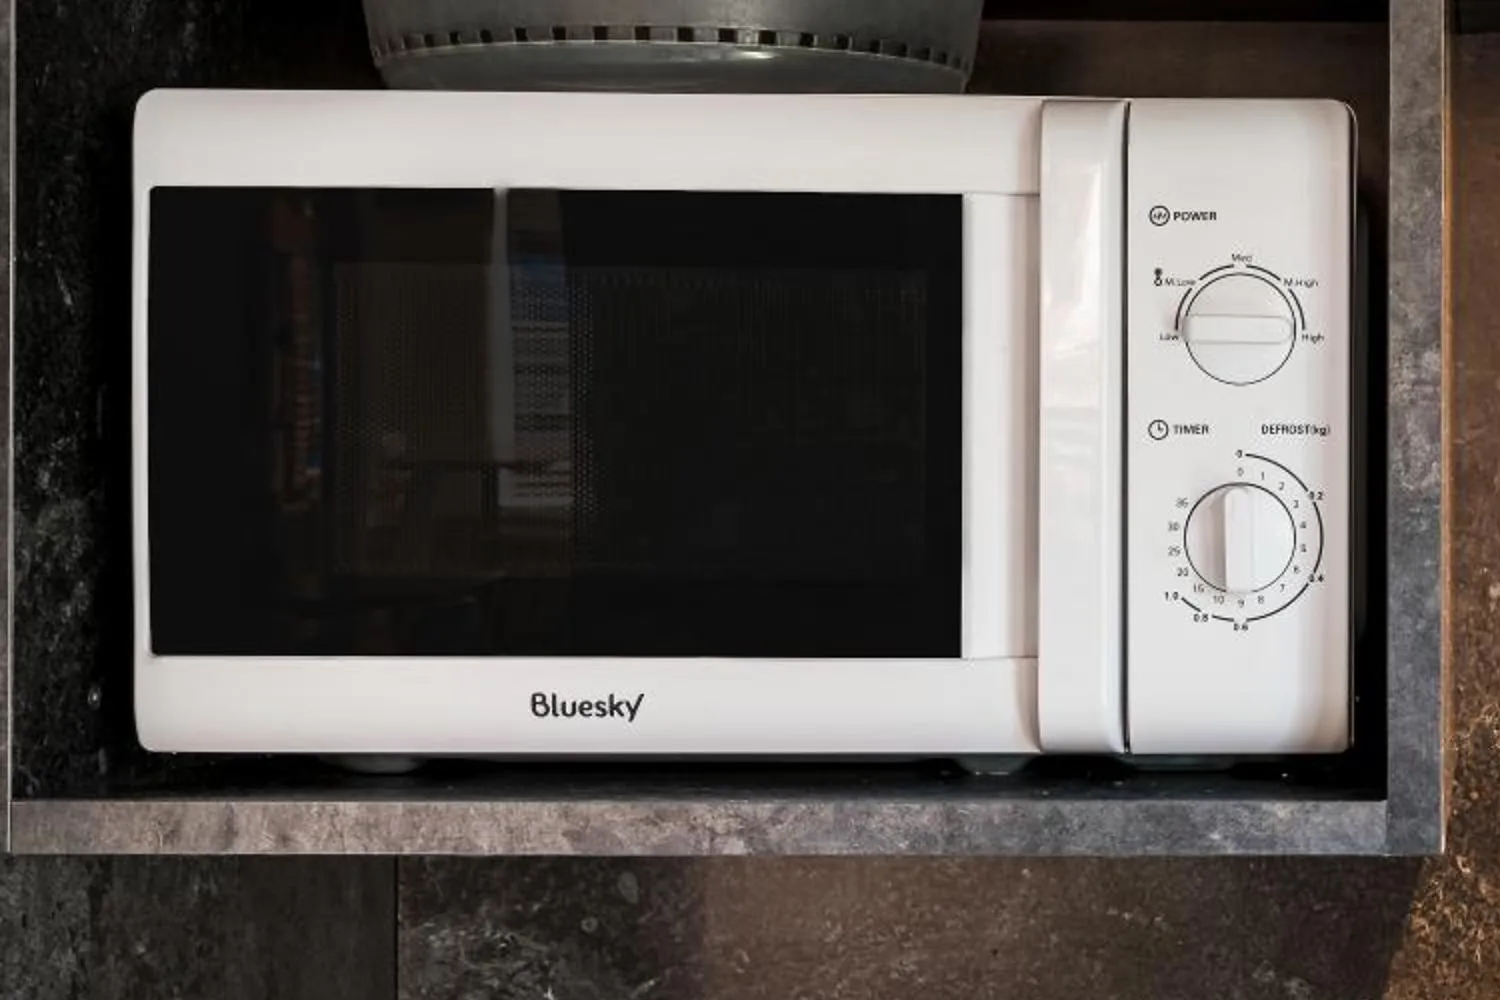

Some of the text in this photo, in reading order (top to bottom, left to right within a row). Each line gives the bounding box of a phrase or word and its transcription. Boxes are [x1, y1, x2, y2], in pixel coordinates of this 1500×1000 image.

[1173, 211, 1217, 222] POWER
[1231, 253, 1253, 263] Med
[1160, 333, 1180, 342] Low
[1301, 333, 1325, 344] High
[1173, 424, 1210, 435] TIMER
[530, 692, 645, 723] Bluesky
